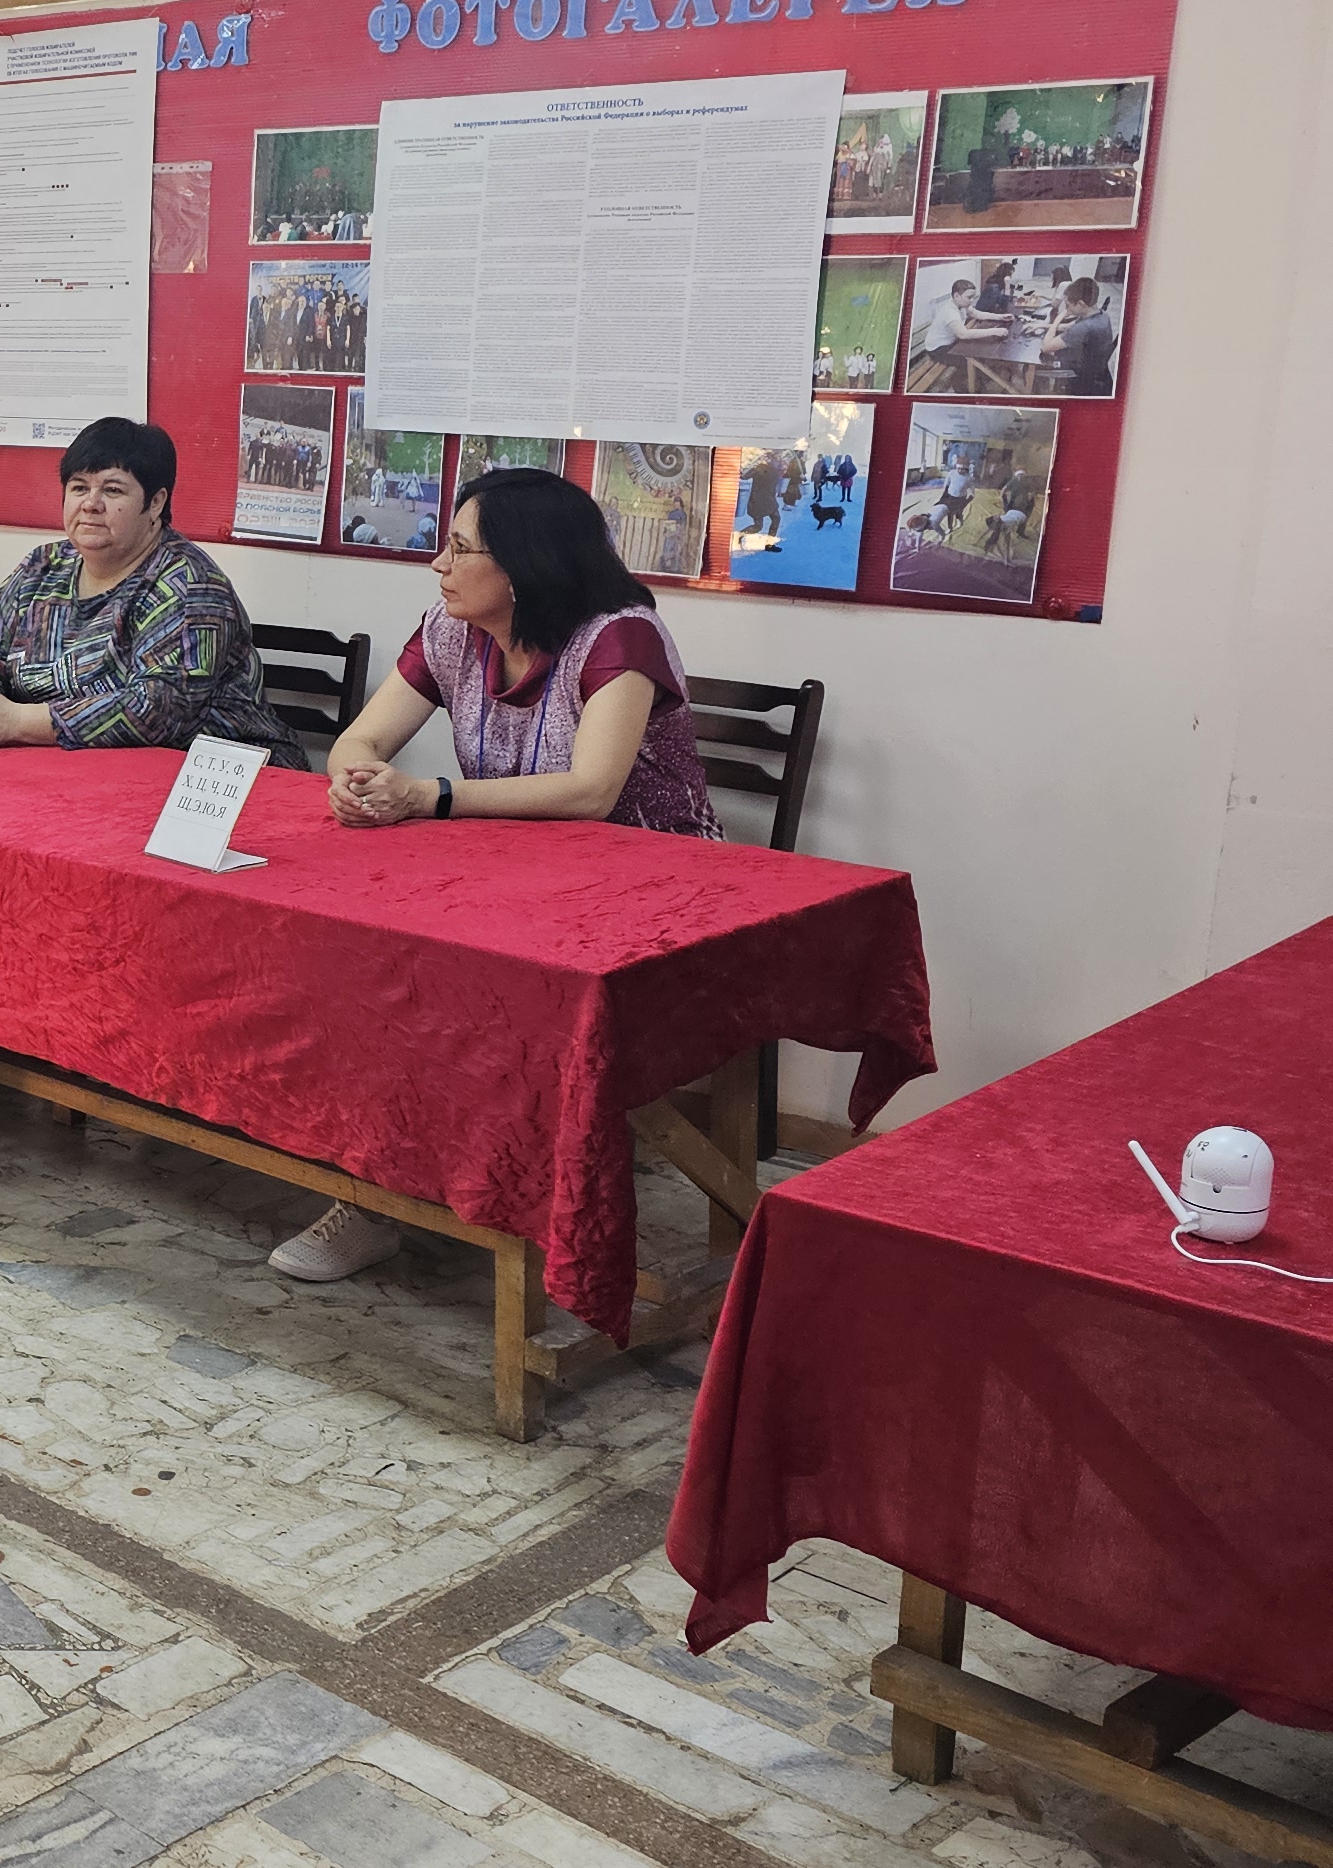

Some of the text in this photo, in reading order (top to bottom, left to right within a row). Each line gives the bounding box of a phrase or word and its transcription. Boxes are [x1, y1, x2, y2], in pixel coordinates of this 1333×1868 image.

[546, 98, 644, 112] ОТВЕТСТВЕННОСТЬ
[561, 112, 602, 122] Российской
[604, 110, 644, 120] Федерации
[652, 108, 684, 117] выборах
[692, 105, 748, 116] референдумах
